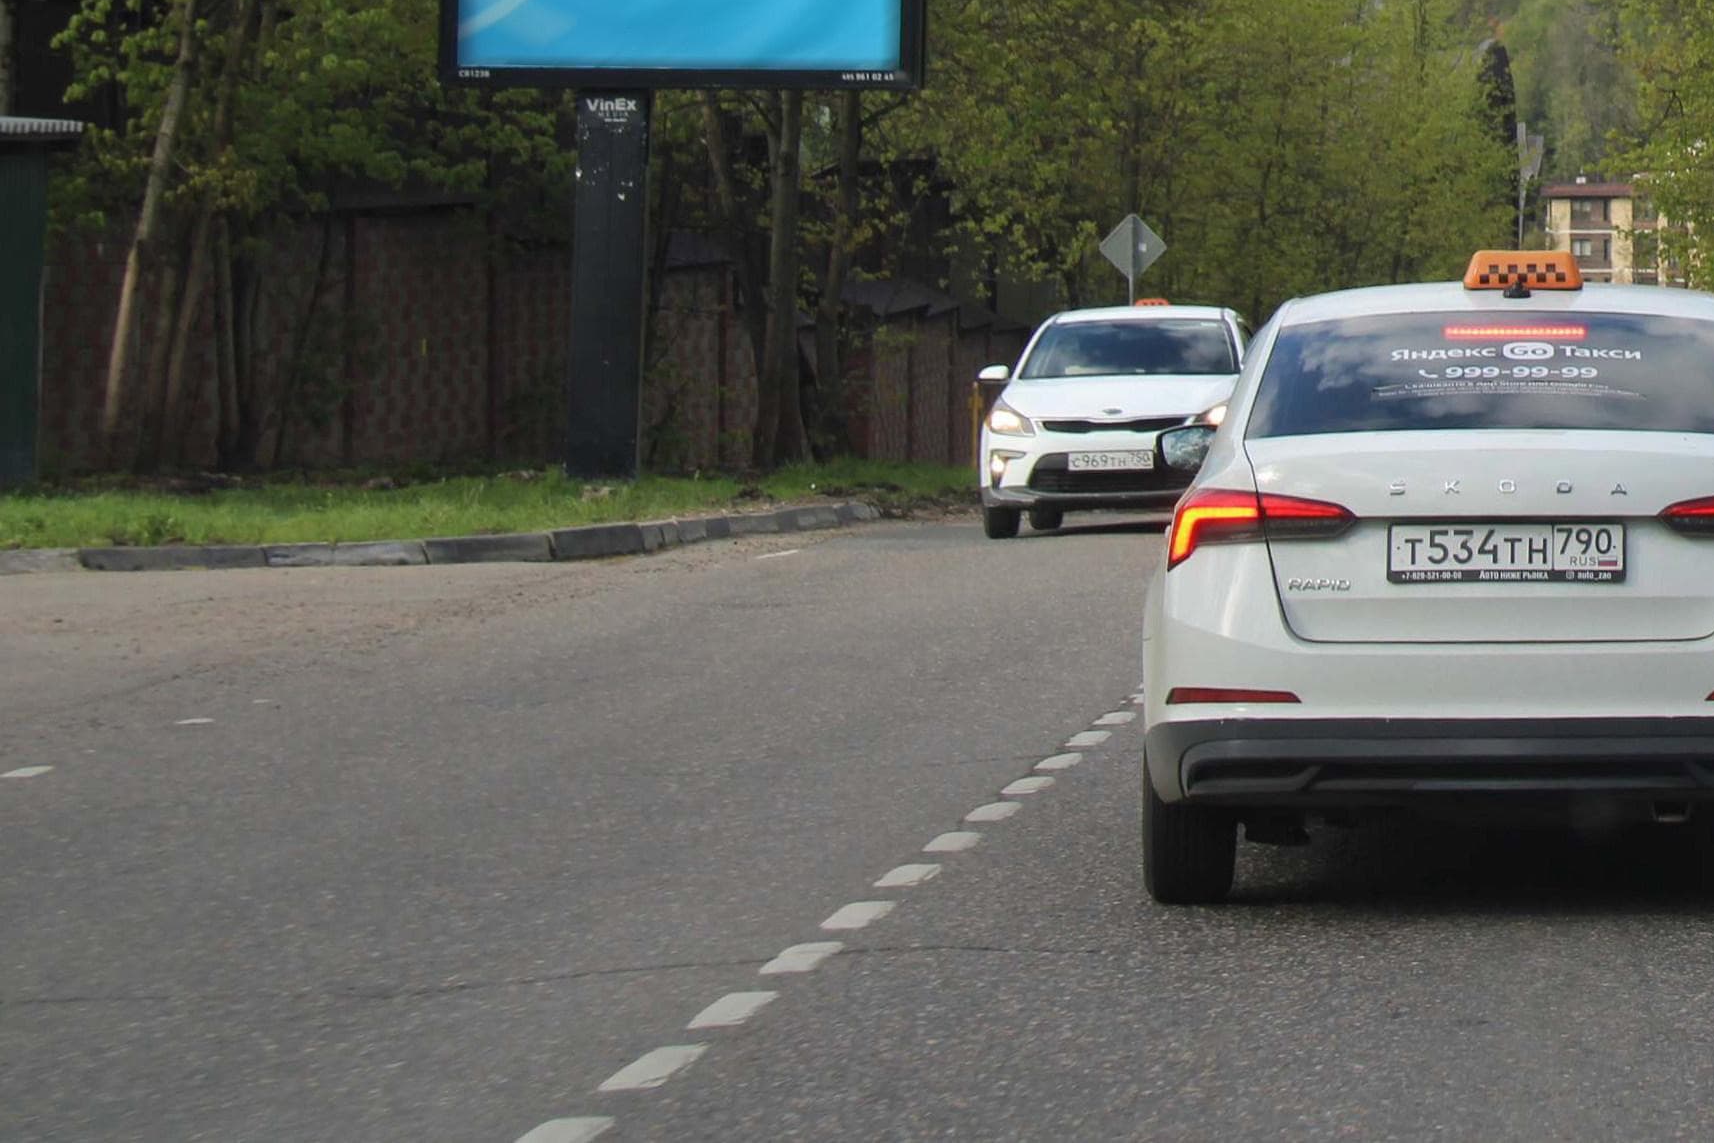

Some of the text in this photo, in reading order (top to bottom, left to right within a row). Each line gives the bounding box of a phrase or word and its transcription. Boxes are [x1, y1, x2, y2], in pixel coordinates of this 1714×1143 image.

[585, 97, 637, 111] VinEx
[1391, 346, 1496, 361] Яндекс
[1559, 345, 1642, 360] Такси
[1445, 366, 1599, 379] 999-99-99
[1556, 528, 1613, 555] 790
[1569, 556, 1597, 566] RUS
[1289, 578, 1350, 591] RAPID
